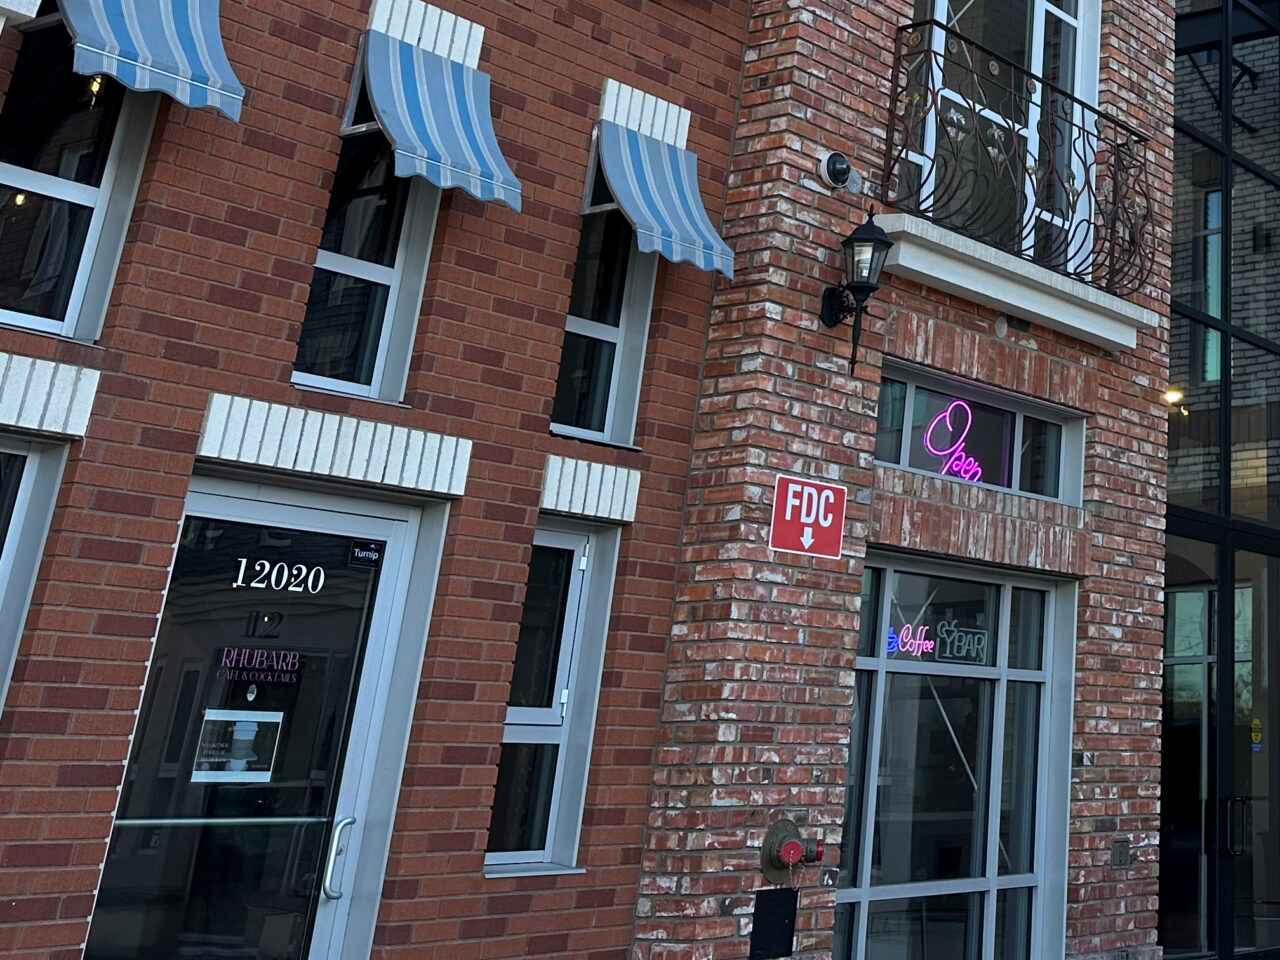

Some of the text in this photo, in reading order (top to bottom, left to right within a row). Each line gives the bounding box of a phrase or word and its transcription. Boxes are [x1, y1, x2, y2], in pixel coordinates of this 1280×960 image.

[924, 400, 983, 482] Open
[784, 482, 835, 528] FDC
[353, 547, 379, 561] Turnip
[232, 557, 326, 594] 12020
[898, 623, 935, 657] Coffee
[221, 647, 300, 672] RHUBARB
